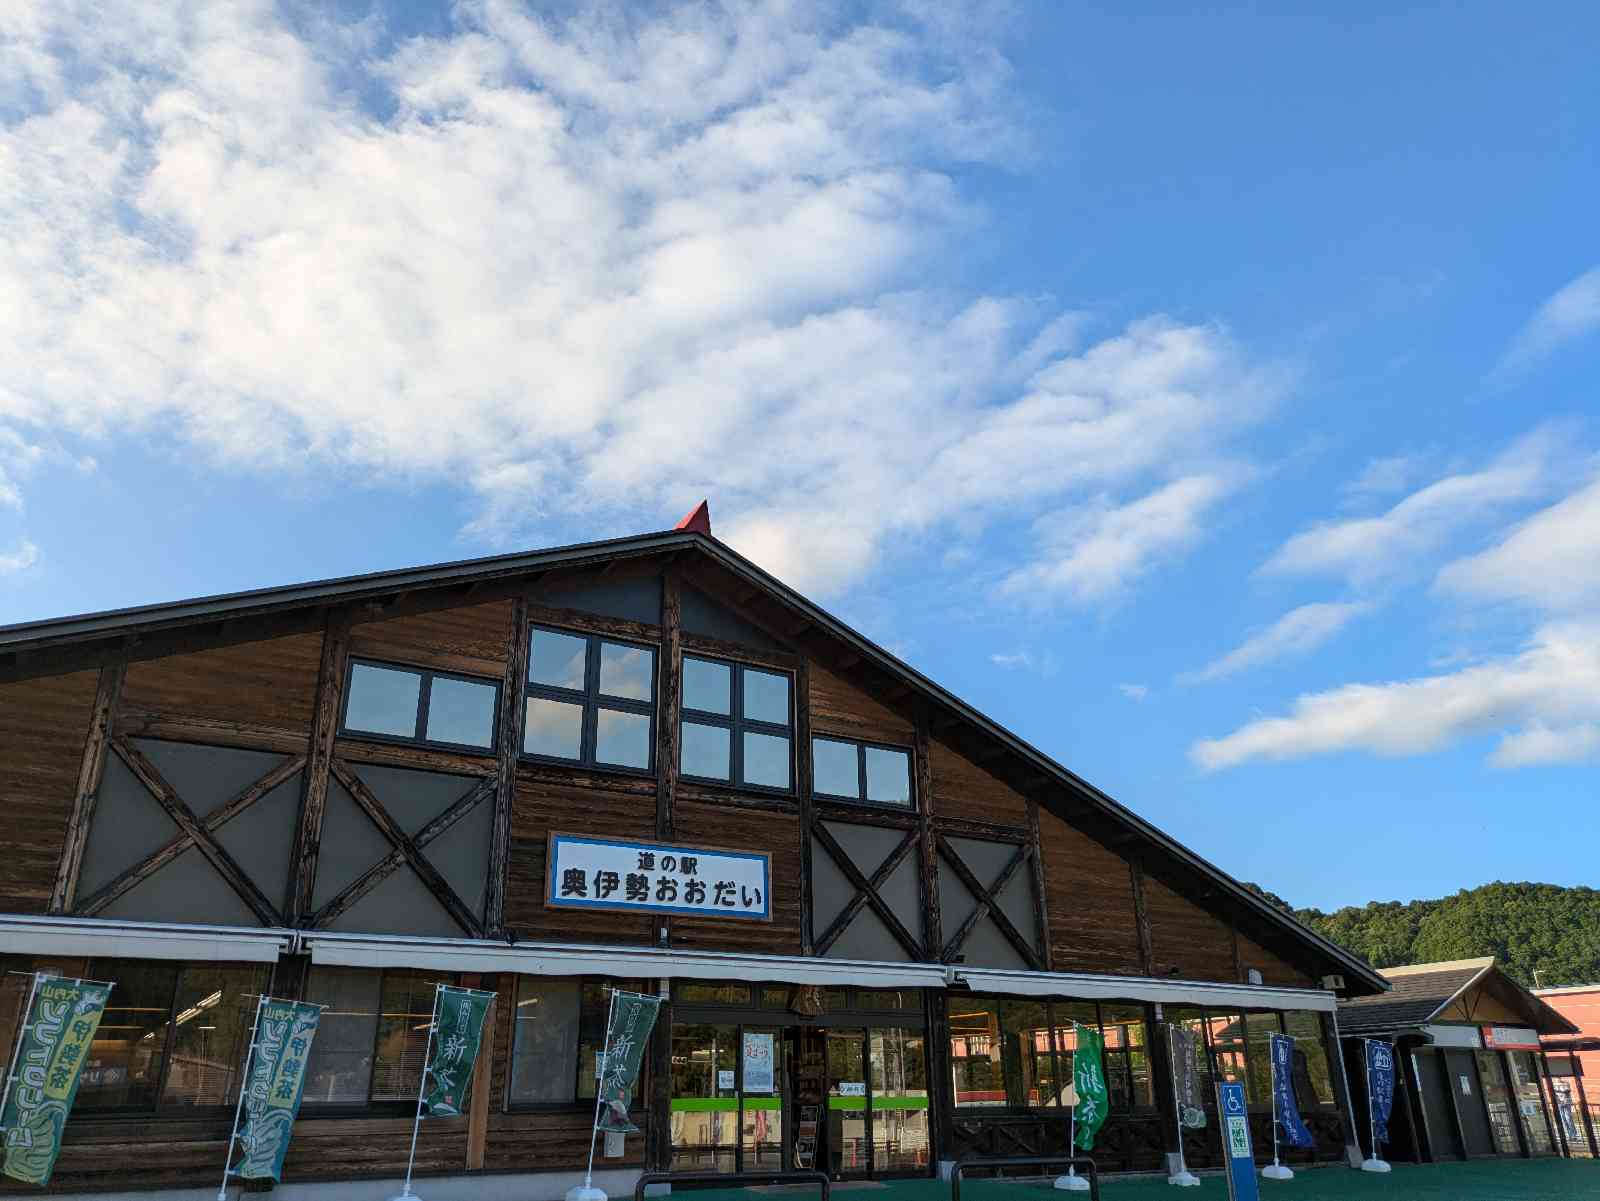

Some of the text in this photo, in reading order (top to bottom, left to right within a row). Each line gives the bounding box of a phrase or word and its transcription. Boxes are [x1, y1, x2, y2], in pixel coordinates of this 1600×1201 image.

[637, 851, 698, 875] 道の駅
[561, 868, 762, 908] 奥伊勢おおだい
